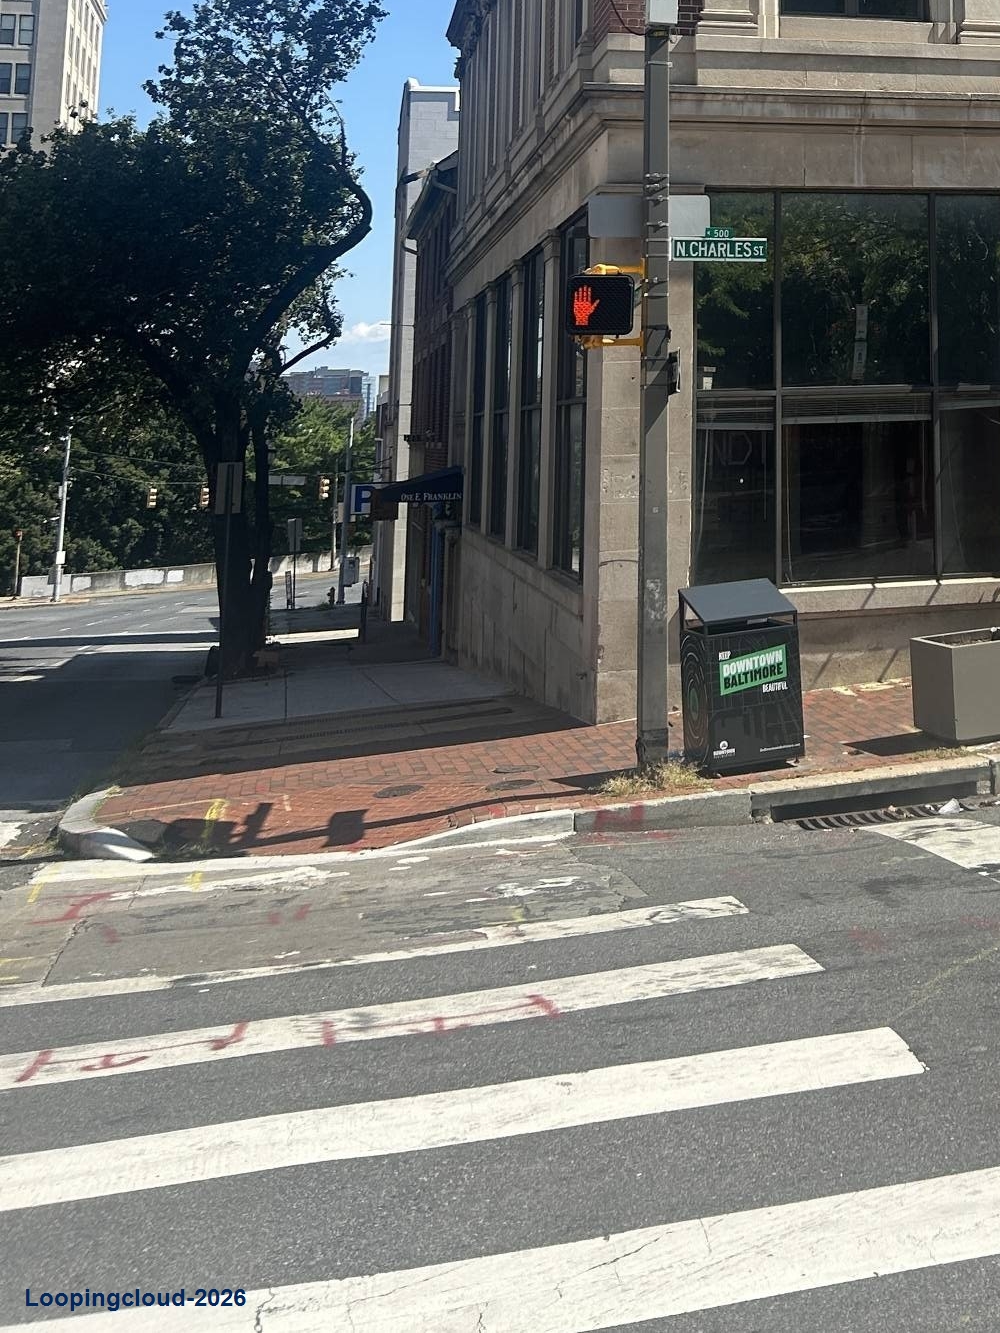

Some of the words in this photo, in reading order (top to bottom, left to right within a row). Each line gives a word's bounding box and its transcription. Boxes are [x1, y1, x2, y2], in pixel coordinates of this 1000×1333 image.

[714, 229, 729, 237] 500
[753, 246, 764, 256] ST
[354, 485, 375, 513] P
[423, 492, 462, 501] FRANKLIN
[718, 650, 732, 661] KEEP
[723, 649, 783, 678] DOWNTOWN
[724, 662, 784, 690] BALTIMORE
[762, 680, 789, 693] BEAUTIFUL
